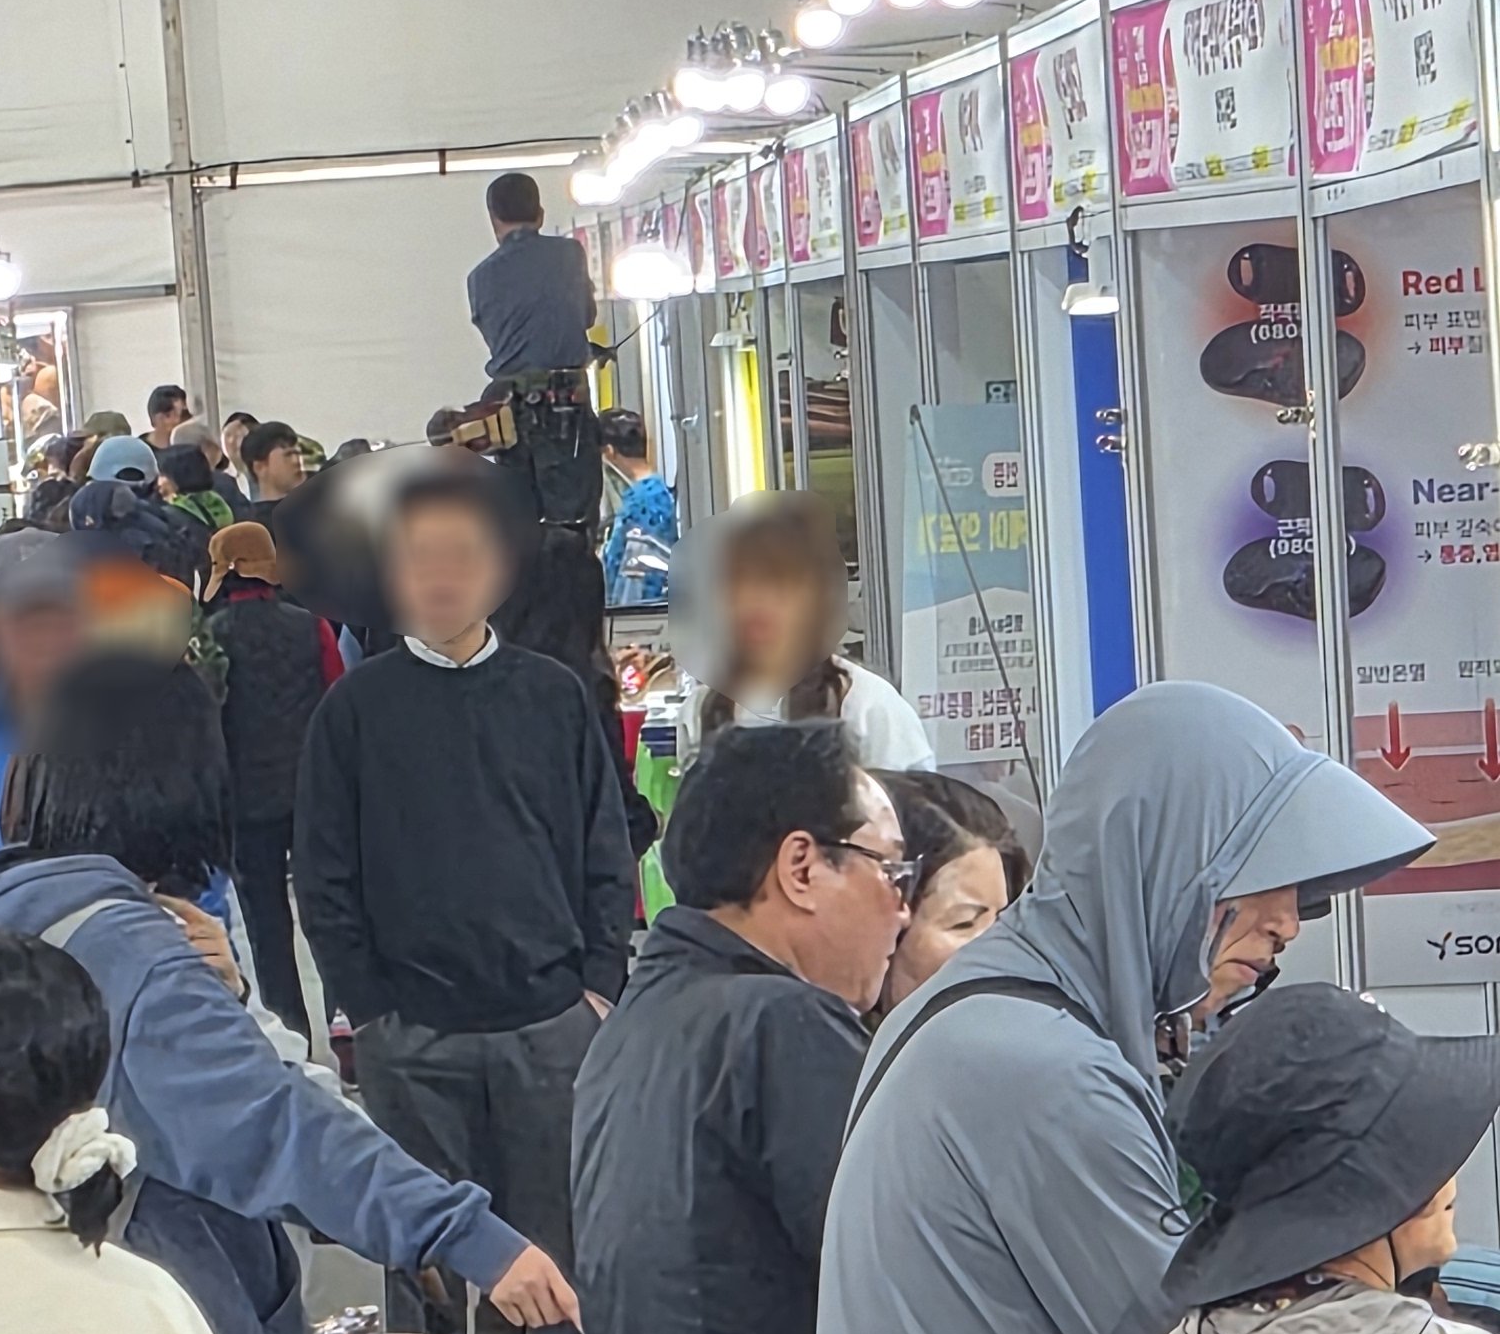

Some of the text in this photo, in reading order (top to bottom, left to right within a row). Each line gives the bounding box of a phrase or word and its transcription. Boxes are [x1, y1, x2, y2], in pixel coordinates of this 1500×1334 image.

[1402, 267, 1464, 296] Red
[1404, 310, 1482, 330] 피부 표면
[1415, 520, 1449, 539] 피부
